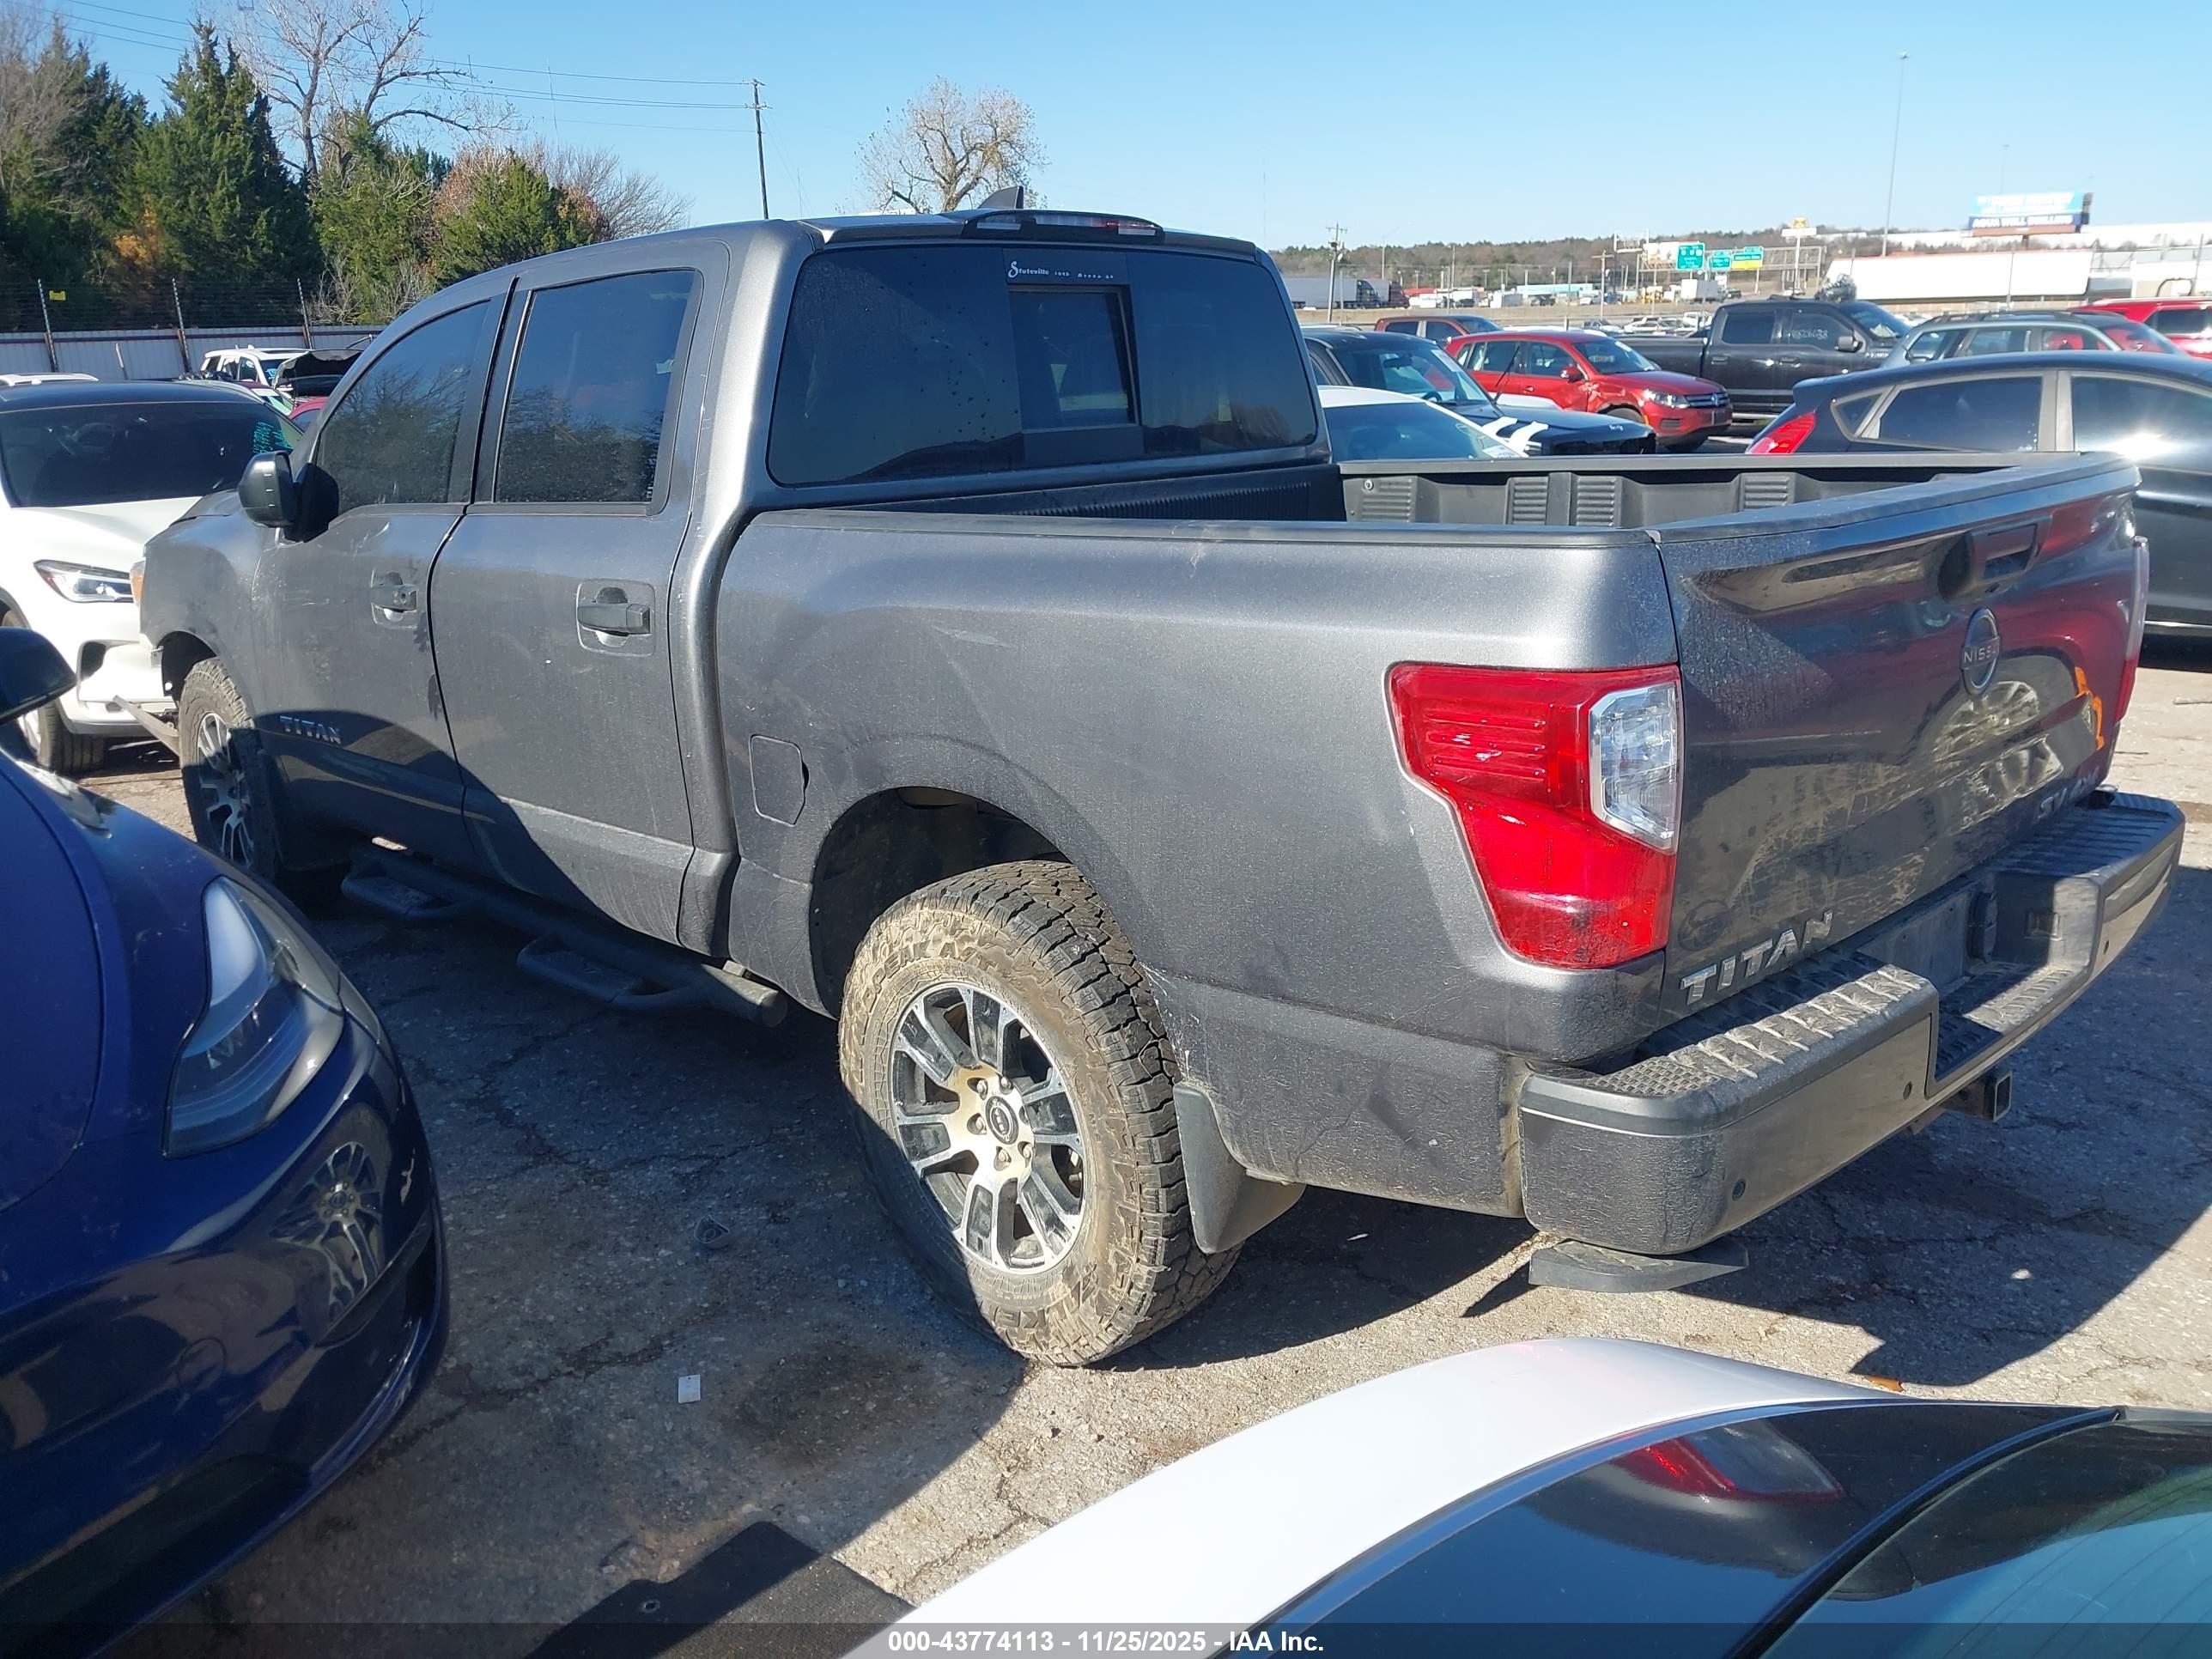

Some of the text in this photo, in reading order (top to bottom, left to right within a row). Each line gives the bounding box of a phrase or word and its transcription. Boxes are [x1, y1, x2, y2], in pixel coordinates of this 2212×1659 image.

[1008, 260, 1049, 278] Stuteville
[1963, 644, 1998, 664] NISS
[279, 714, 342, 745] TITAN
[1680, 910, 1833, 1006] TITAN
